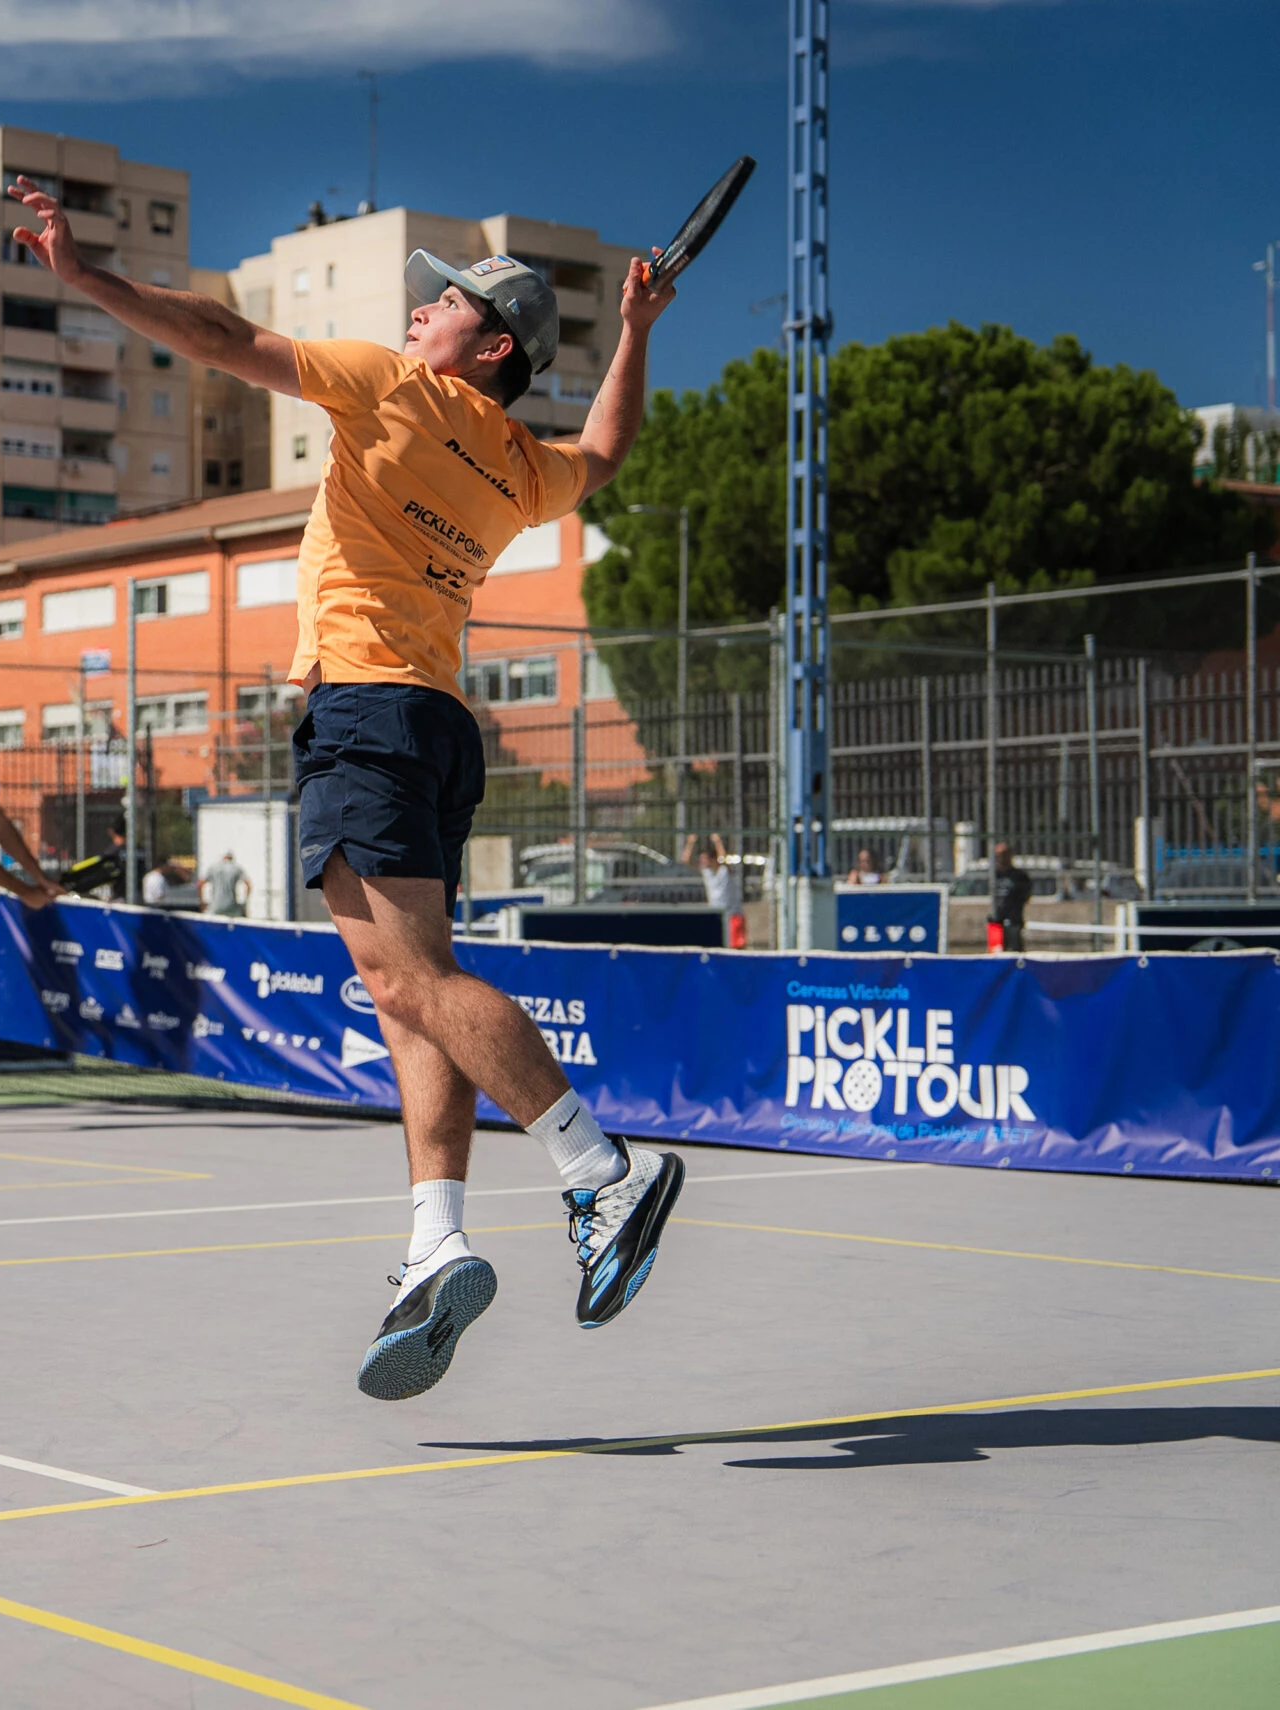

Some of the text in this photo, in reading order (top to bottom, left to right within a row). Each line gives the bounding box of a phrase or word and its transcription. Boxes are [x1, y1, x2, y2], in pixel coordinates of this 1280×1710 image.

[841, 925, 927, 943] OLVO
[787, 980, 910, 1001] Cervezas Victoria
[509, 995, 586, 1025] EZAS
